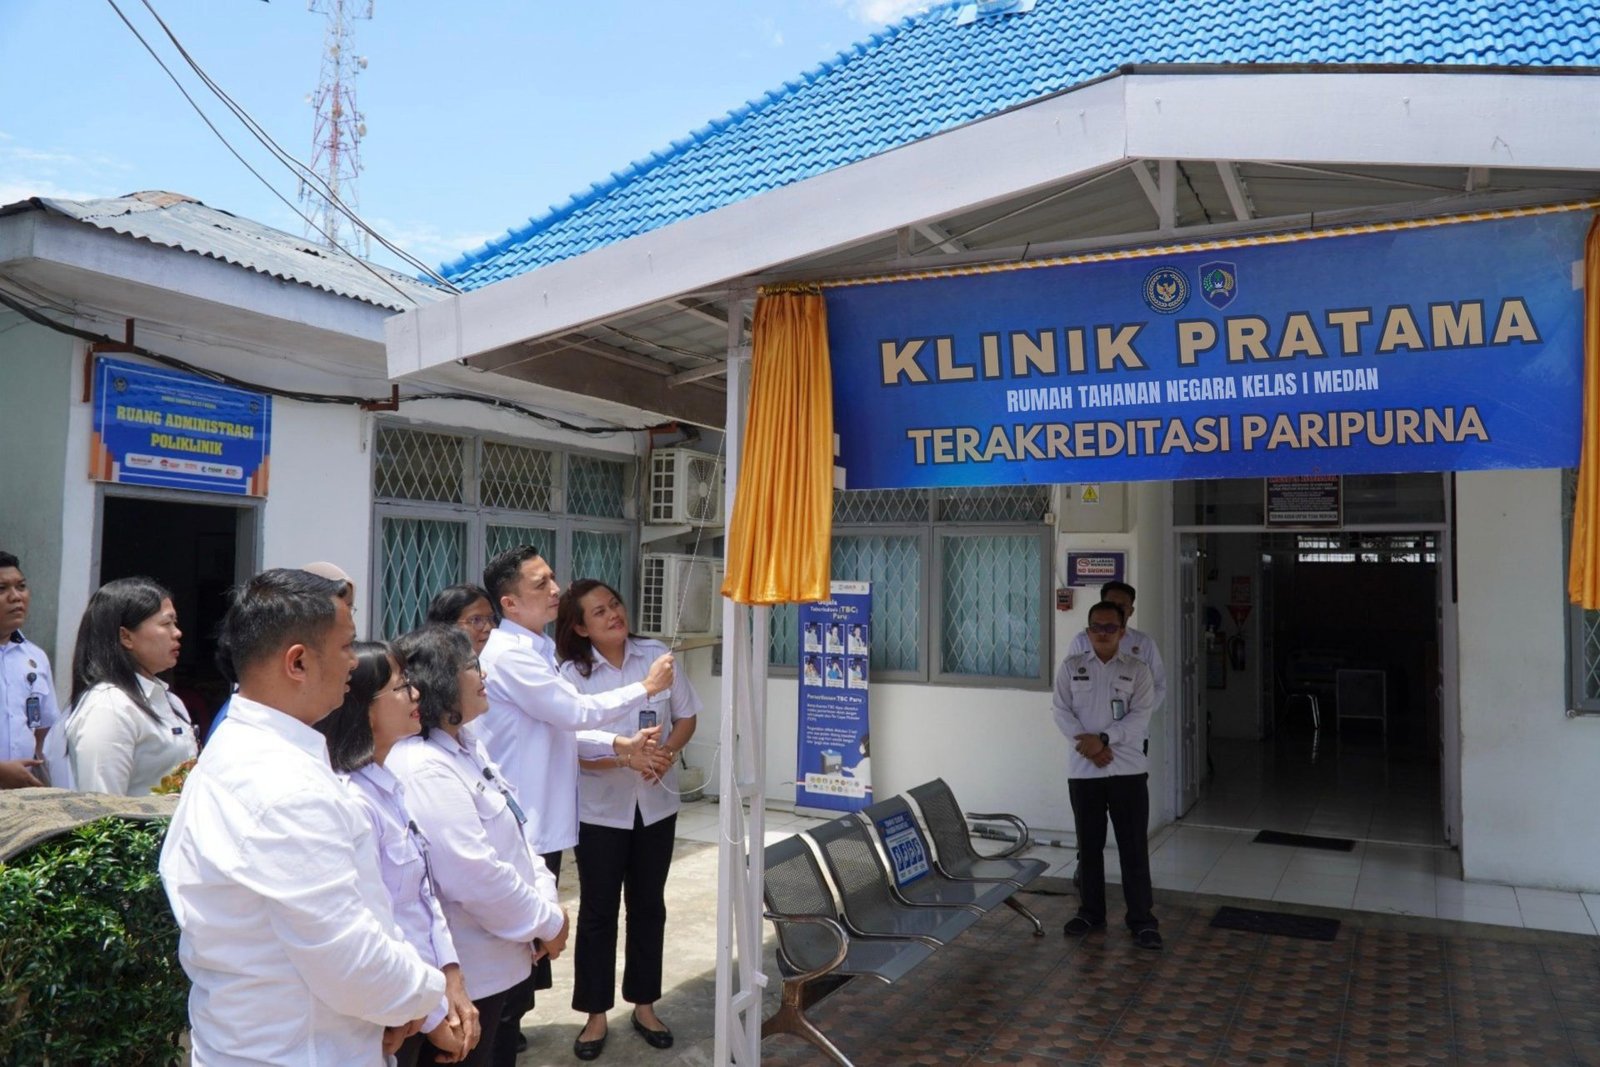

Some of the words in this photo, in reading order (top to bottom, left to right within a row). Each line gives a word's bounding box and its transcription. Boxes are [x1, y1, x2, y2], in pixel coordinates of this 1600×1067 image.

[880, 323, 1150, 386] KLINIK
[1176, 299, 1540, 366] PRATAMA
[1006, 386, 1073, 413] RUMAH
[1077, 380, 1161, 408] TAHANAN
[1166, 376, 1237, 403] NEGARA
[1242, 373, 1297, 398] KELAS
[1302, 371, 1309, 395] I
[1313, 367, 1379, 394] MEDAN
[116, 405, 162, 426] RUANG
[164, 413, 255, 439] ADMINISTRASI
[906, 416, 1231, 465] TERAKREDITASI
[1241, 406, 1490, 451] PARIPURNA
[150, 433, 224, 456] POLIKLINIK
[832, 612, 848, 620] Paru
